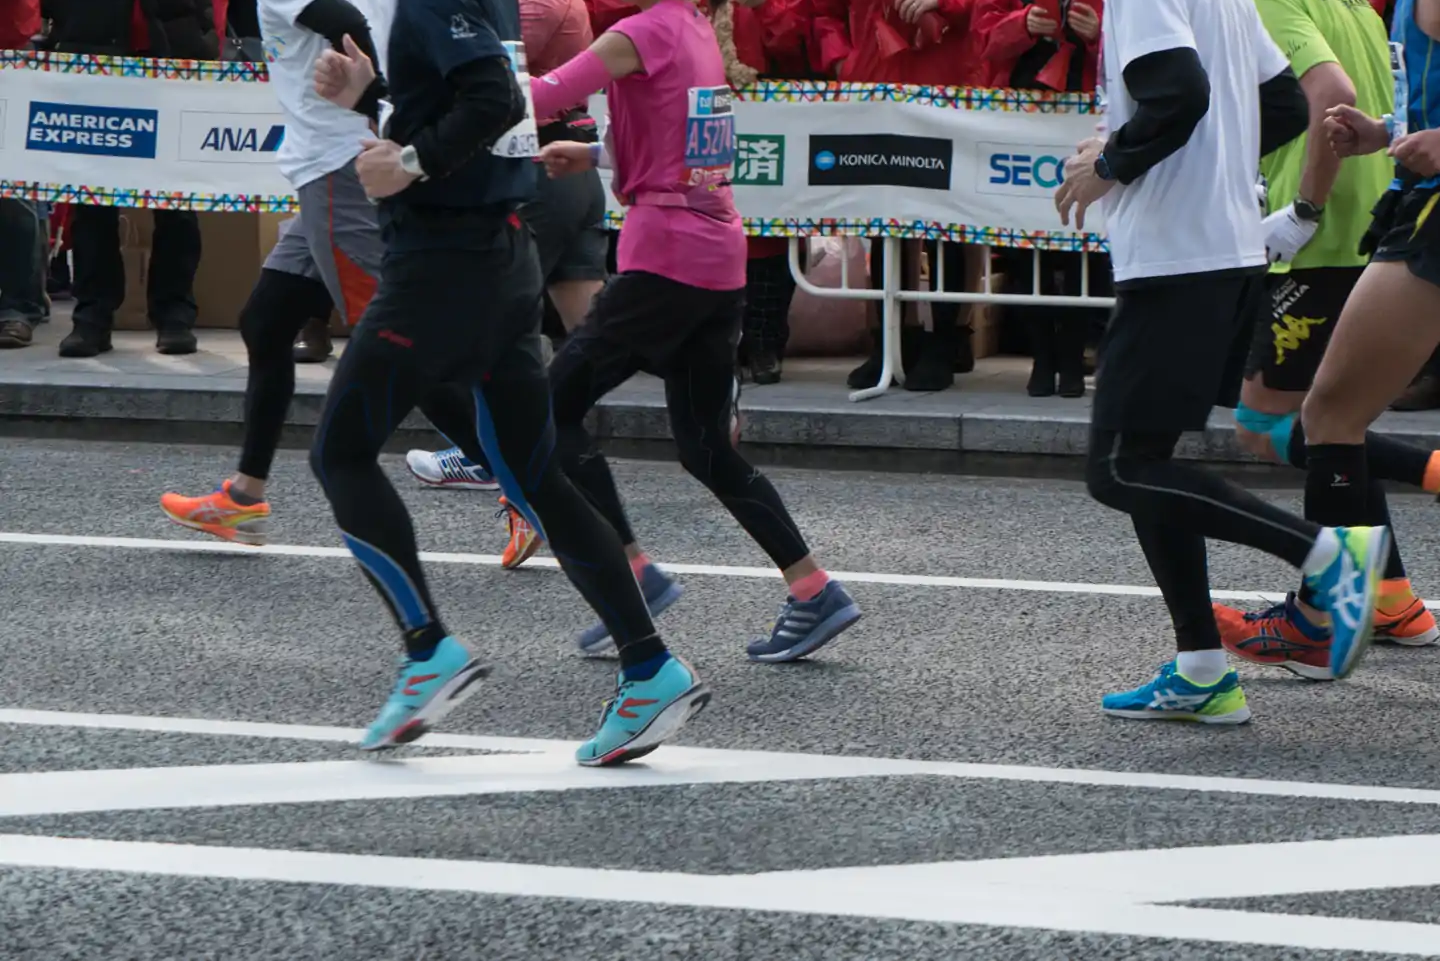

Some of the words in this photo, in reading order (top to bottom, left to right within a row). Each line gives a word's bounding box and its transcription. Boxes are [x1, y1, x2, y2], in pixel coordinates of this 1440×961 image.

[32, 111, 155, 133] AMERICAN
[29, 127, 133, 148] EXPRESS
[200, 127, 258, 152] ANA
[733, 139, 779, 180] 済
[839, 153, 888, 167] KONICA
[890, 155, 945, 170] MINOLTA
